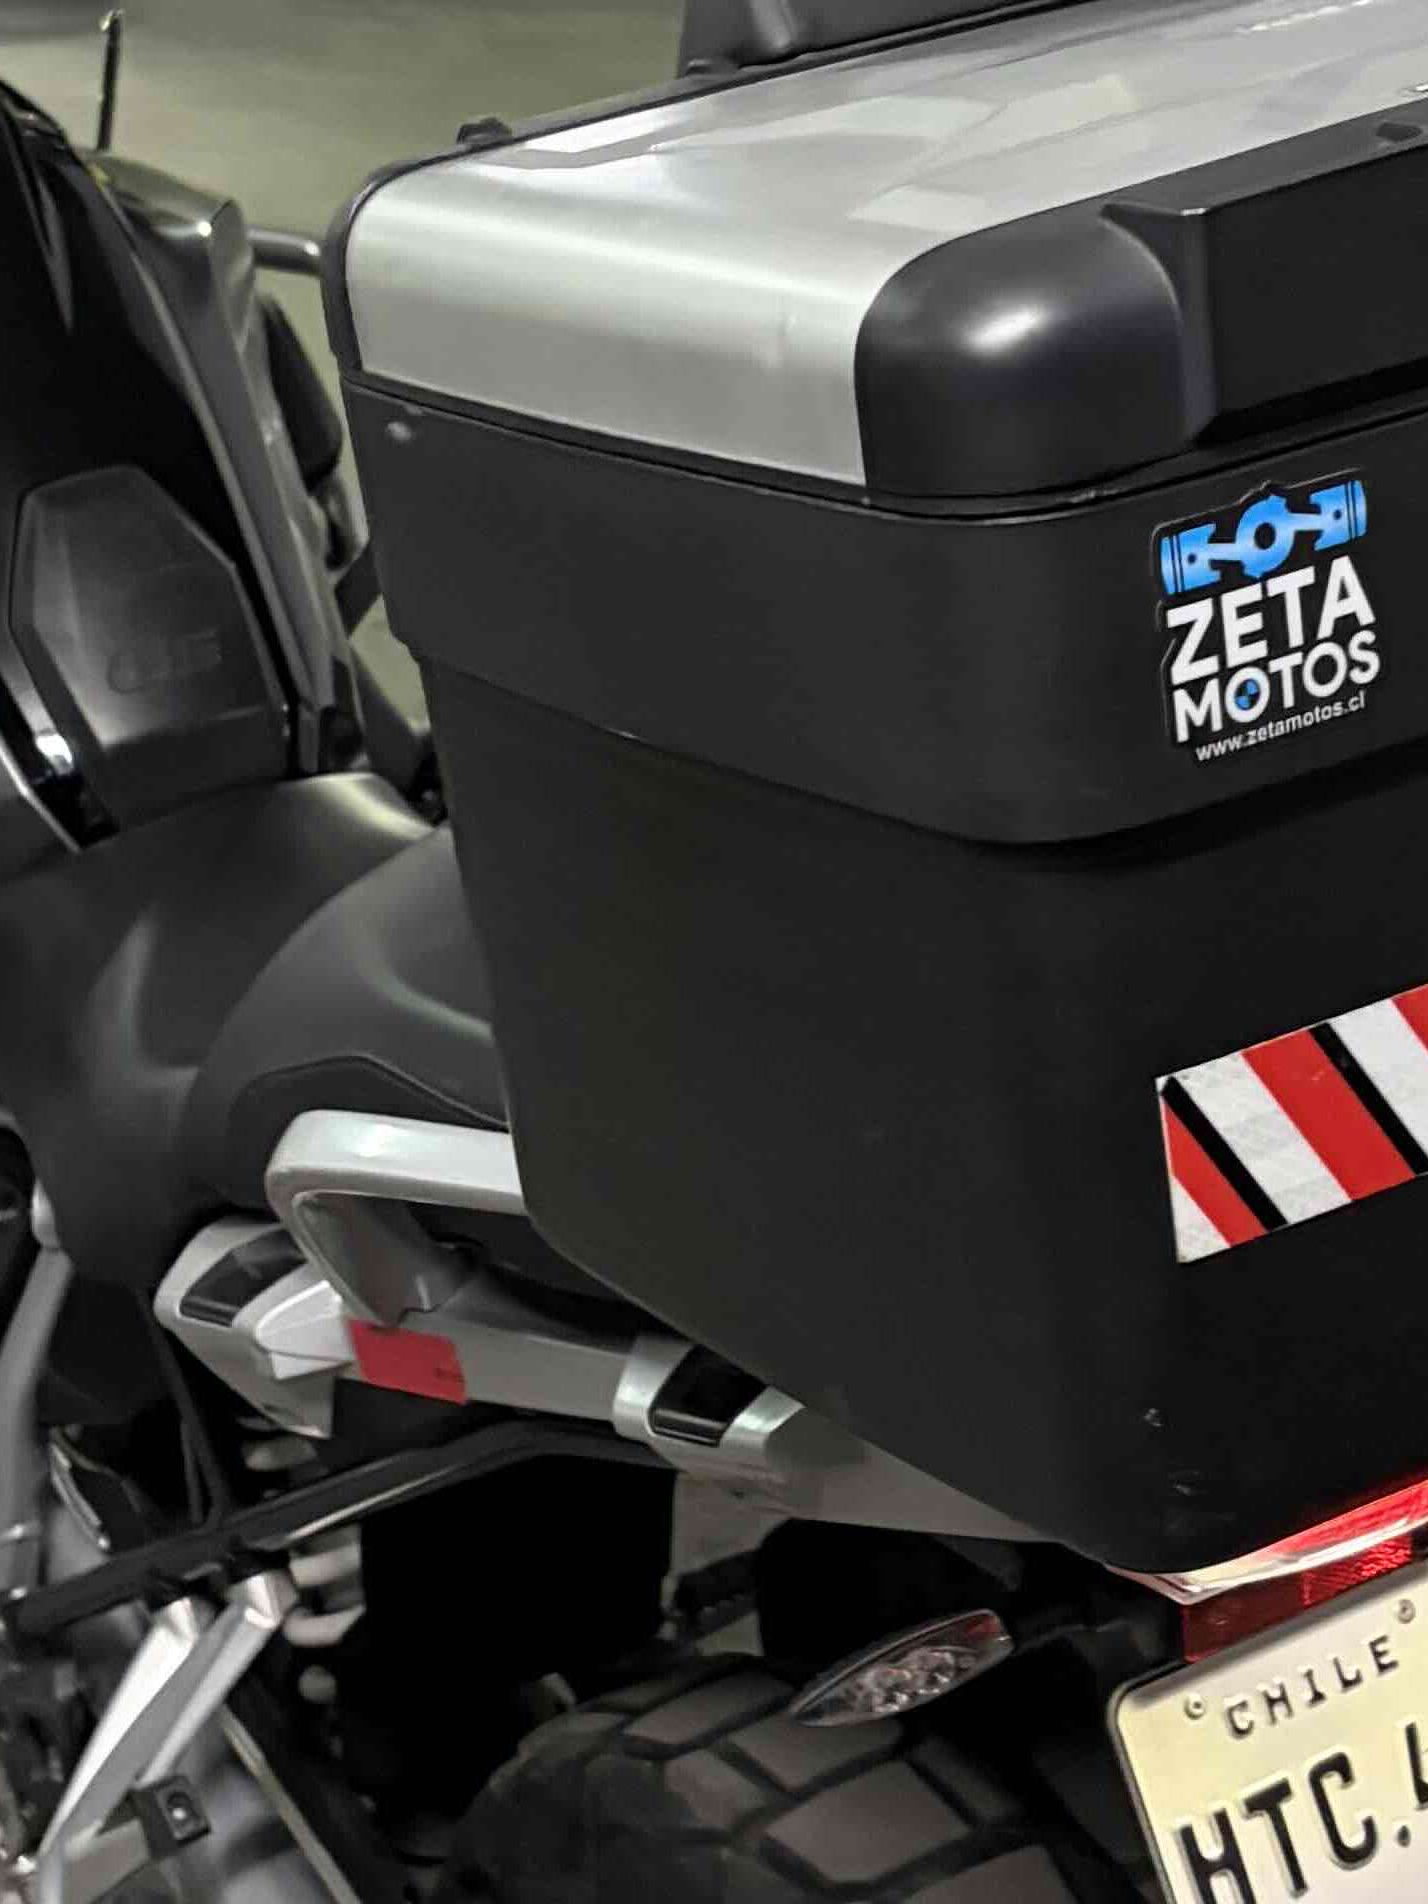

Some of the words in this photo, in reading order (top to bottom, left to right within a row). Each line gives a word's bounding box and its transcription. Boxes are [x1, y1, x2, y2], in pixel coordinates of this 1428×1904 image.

[1167, 555, 1376, 686] ZETA
[1172, 629, 1381, 744] MOTOS
[1195, 690, 1366, 762] www.zetamotos.cl
[1223, 1634, 1400, 1739] CHILE
